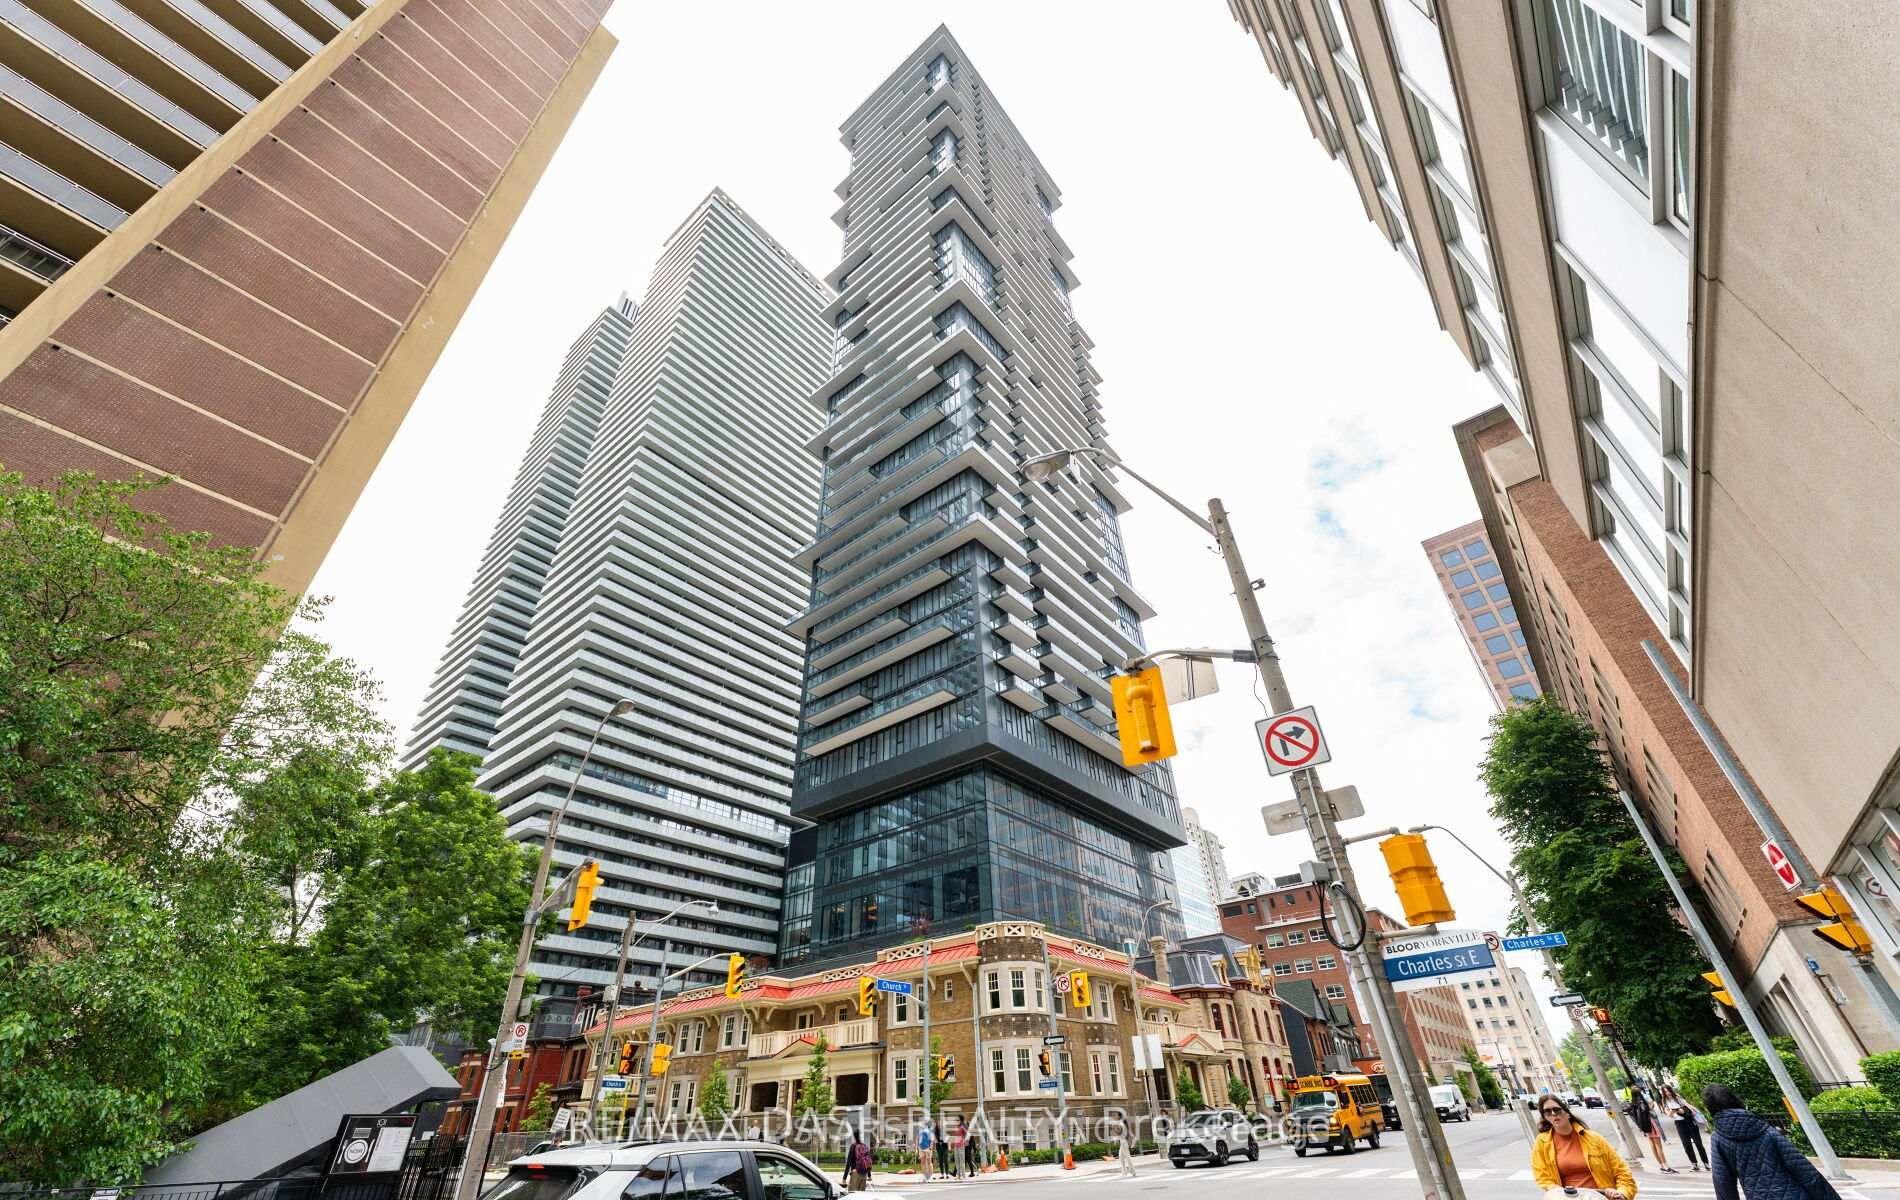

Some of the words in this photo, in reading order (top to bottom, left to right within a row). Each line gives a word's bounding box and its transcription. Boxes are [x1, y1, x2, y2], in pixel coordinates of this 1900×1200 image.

[1386, 932, 1479, 954] BLOORYORKVILLE
[1507, 938, 1546, 949] Charles
[1554, 935, 1562, 944] E
[1398, 956, 1453, 976] Charles
[1454, 954, 1466, 967] St
[1468, 949, 1480, 965] E
[882, 981, 902, 991] Church
